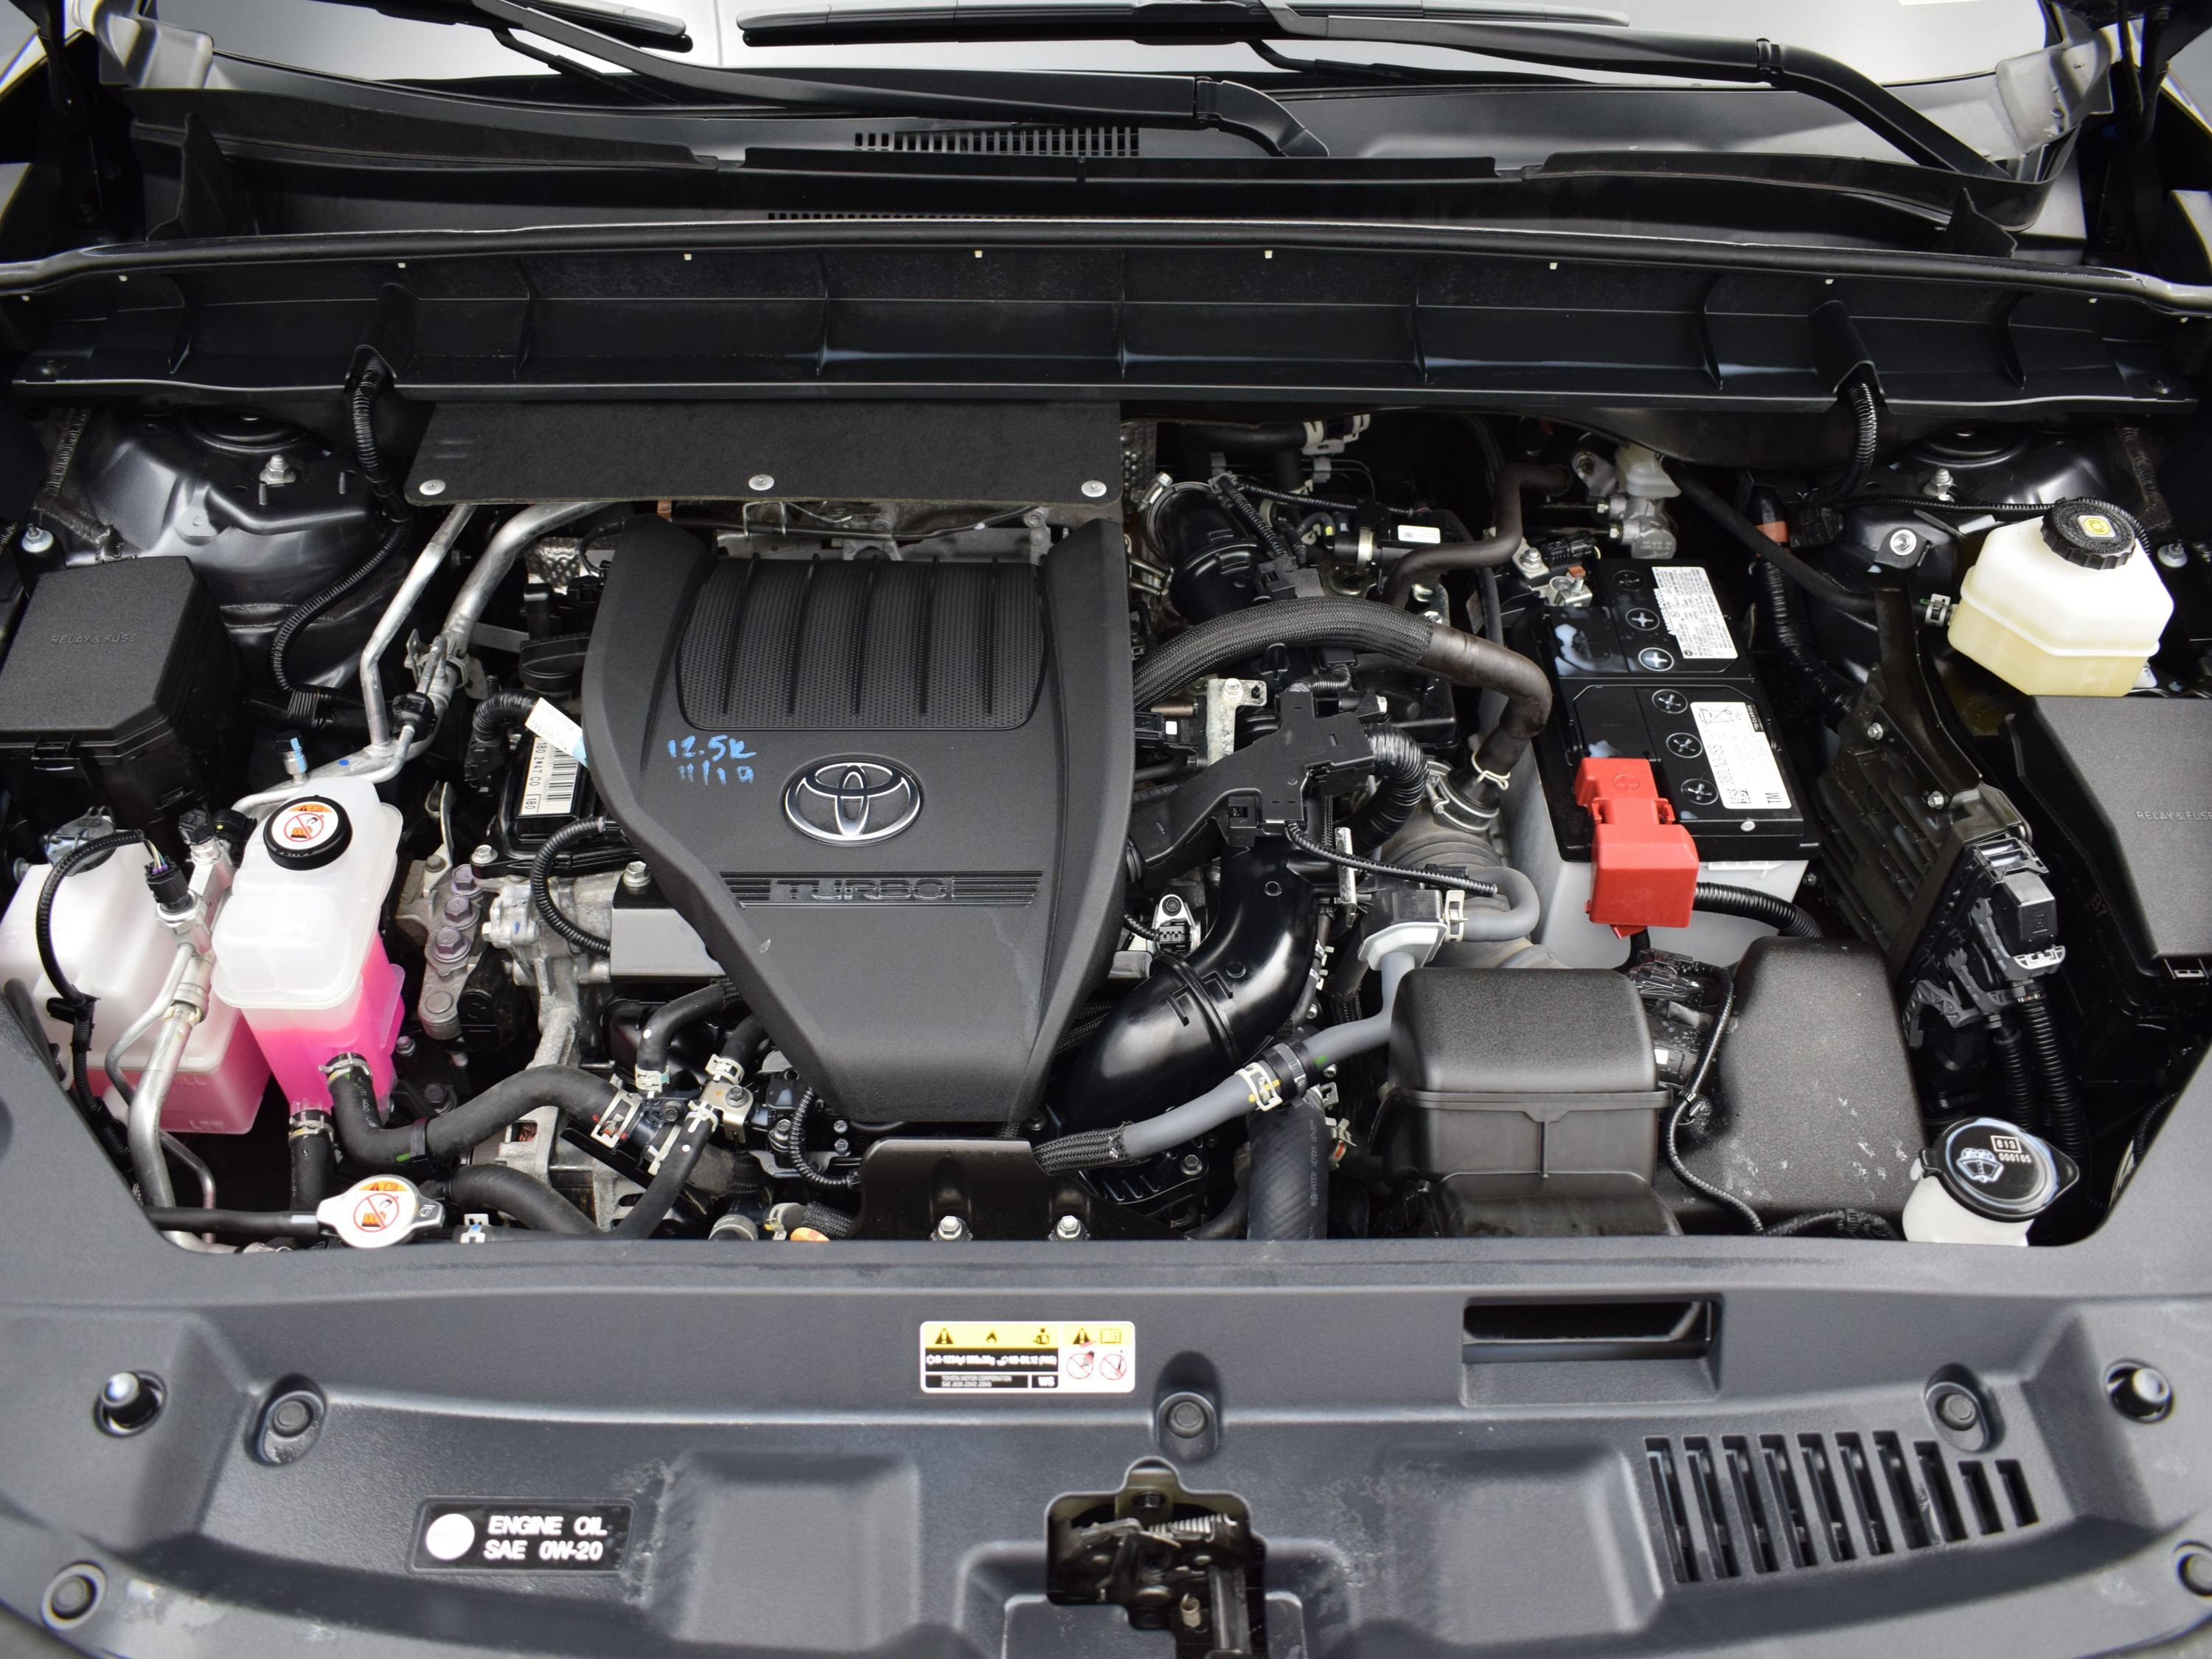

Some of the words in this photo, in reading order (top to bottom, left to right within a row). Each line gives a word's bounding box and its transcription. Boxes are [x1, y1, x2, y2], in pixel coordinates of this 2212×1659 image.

[105, 633, 138, 643] FUSE
[535, 742, 547, 754] 180
[524, 797, 537, 810] 180
[1766, 791, 1783, 804] TM
[2135, 810, 2172, 820] RELAY
[2175, 812, 2183, 820] &
[776, 878, 947, 901] TURBO
[1996, 1139, 2016, 1150] e13
[1998, 1152, 2032, 1164] 000105
[487, 1515, 563, 1536] ENGINE
[574, 1516, 608, 1536] OIL
[483, 1540, 528, 1560] SAE
[539, 1540, 604, 1562] 0W-20
